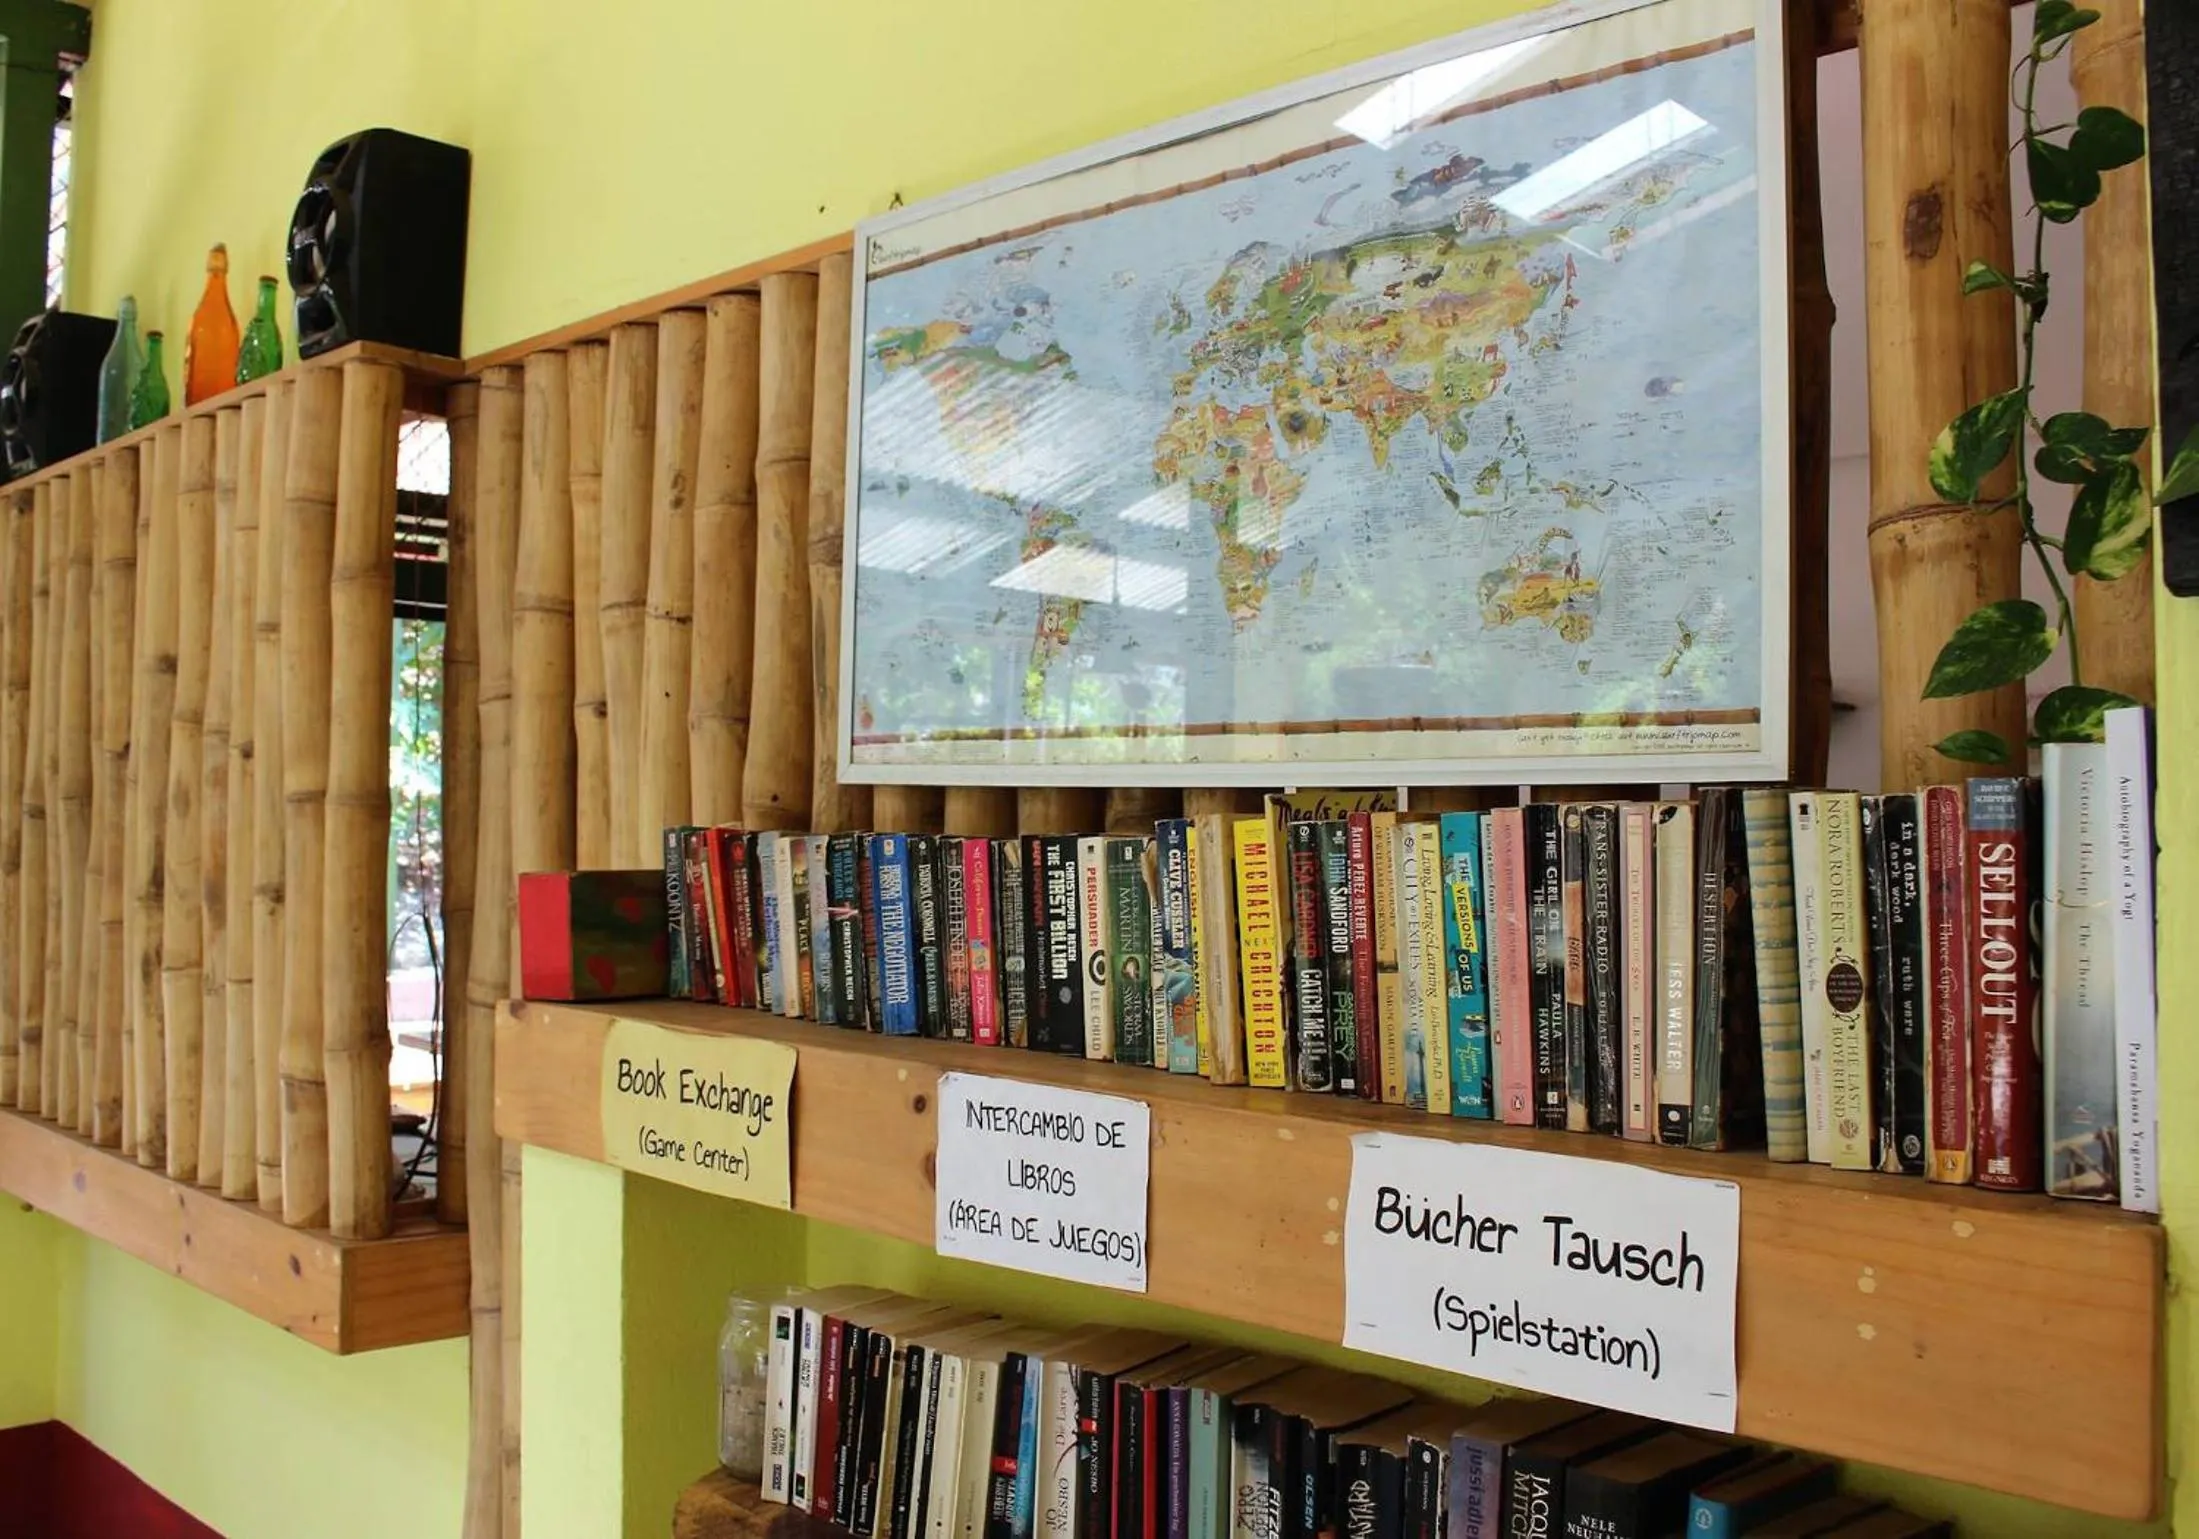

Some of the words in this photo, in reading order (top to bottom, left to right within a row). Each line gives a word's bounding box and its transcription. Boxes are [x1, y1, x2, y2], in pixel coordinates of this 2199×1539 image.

[2078, 767, 2094, 835] Victoria
[2118, 776, 2134, 862] Autobiography
[1351, 826, 1364, 858] Arturo
[1546, 830, 1557, 858] THE
[1826, 799, 1844, 856] NORA
[1902, 821, 1916, 840] in
[1047, 844, 1061, 865] THE
[1169, 848, 1182, 889] CLIVE
[1292, 849, 1313, 885] LISA
[1328, 850, 1346, 885] JOHN
[1421, 848, 1436, 885] Living,
[1458, 858, 1468, 881] THE
[1594, 810, 1609, 919] TRANS-SISTER
[1891, 841, 1903, 882] dark
[2076, 841, 2095, 898] Hislop
[2122, 865, 2136, 878] of
[665, 872, 683, 932] KOONTZ
[917, 864, 930, 897] PATRICIA
[946, 864, 964, 916] JOSEPH
[1048, 870, 1066, 916] FIRST
[1065, 861, 1076, 931] CHRISTOPHER
[1244, 842, 1271, 933] MICHAEL
[1403, 857, 1421, 904] CITY
[1533, 887, 1546, 920] THE
[1546, 866, 1560, 904] GIRL
[1829, 860, 1846, 944] ROBERTS
[1902, 861, 1916, 908] dark,
[881, 903, 905, 930] THE
[920, 900, 936, 944] CORNWELL
[1086, 867, 1098, 947] PERSUADER
[1119, 887, 1133, 951] MARTIN
[1171, 892, 1184, 950] CUSSLER
[1297, 888, 1319, 958] GARDNER
[1330, 886, 1349, 953] SANDFORD
[1423, 887, 1438, 929] Loving
[1456, 886, 1473, 948] VERSIONS
[1702, 872, 1717, 965] DESERTION
[1892, 886, 1905, 923] wood
[2120, 892, 2137, 922] Yogi
[842, 920, 853, 974] CHRISTOPHER
[949, 920, 964, 970] FINDER
[1050, 920, 1068, 979] BILLION
[1066, 933, 1077, 962] REICH
[1409, 921, 1421, 969] EXILES
[1534, 923, 1548, 975] TRAIN
[1597, 924, 1609, 974] RADIO
[1938, 919, 1955, 961] Three
[1978, 842, 2018, 1024] SELLOUT
[2078, 923, 2092, 949] The
[818, 952, 832, 992] RETURN
[883, 931, 909, 1004] NEGOTIATOR
[1425, 944, 1439, 998] Learning
[1459, 953, 1469, 972] OF
[1461, 975, 1471, 992] US
[1668, 960, 1684, 998] JESS
[1901, 956, 1915, 992] ruth
[1936, 966, 1956, 999] Cups
[2078, 955, 2092, 1009] Thread
[844, 976, 854, 1001] REICH
[1090, 990, 1100, 1011] LEE
[1249, 951, 1276, 1053] CRICHTON
[1299, 968, 1323, 1016] CATCH
[1091, 1016, 1102, 1052] CHILD
[1124, 986, 1135, 1046] SWORDS
[1133, 992, 1143, 1036] STORM
[1303, 1018, 1324, 1039] ME
[1333, 990, 1349, 1061] PREY
[1551, 993, 1563, 1038] PAULA
[1903, 1000, 1914, 1036] ware
[1939, 1015, 1957, 1041] Tea
[1537, 1007, 1552, 1075] HAWKINS
[1632, 1043, 1643, 1080] WHITE
[1667, 1007, 1683, 1070] WALTER
[1847, 1035, 1860, 1068] THE
[1831, 1027, 1847, 1118] BOYFRIEND
[1848, 1073, 1861, 1112] LAST
[2127, 1041, 2144, 1125] Paramahansa
[616, 1057, 668, 1101] Book
[677, 1068, 774, 1137] Exchange
[964, 1098, 1085, 1145] INTERCAMBIO
[1095, 1120, 1127, 1149] DE
[638, 1125, 686, 1164] (Game
[693, 1138, 751, 1182] Center)
[2129, 1130, 2147, 1200] Yogananda
[1006, 1159, 1077, 1197] LIBROS
[948, 1199, 1002, 1237] (ÁREA
[1010, 1215, 1042, 1244] DE
[1049, 1219, 1142, 1268] JUEGOS)
[1374, 1186, 1518, 1254] Bücher
[1542, 1215, 1704, 1292] Tausch
[1432, 1286, 1661, 1380] (Spielstation)
[1055, 1386, 1067, 1422] Larve
[1091, 1377, 1101, 1418] ullstein
[1172, 1401, 1181, 1422] ANNA
[1055, 1424, 1066, 1447] Die
[1091, 1436, 1099, 1451] JO
[1465, 1446, 1487, 1493] jussi
[1045, 1508, 1058, 1532] JO
[1237, 1484, 1256, 1532] ZERO
[1254, 1481, 1269, 1538] OPTION
[1305, 1474, 1315, 1529] OLSEN
[1580, 1514, 1616, 1533] NELE
